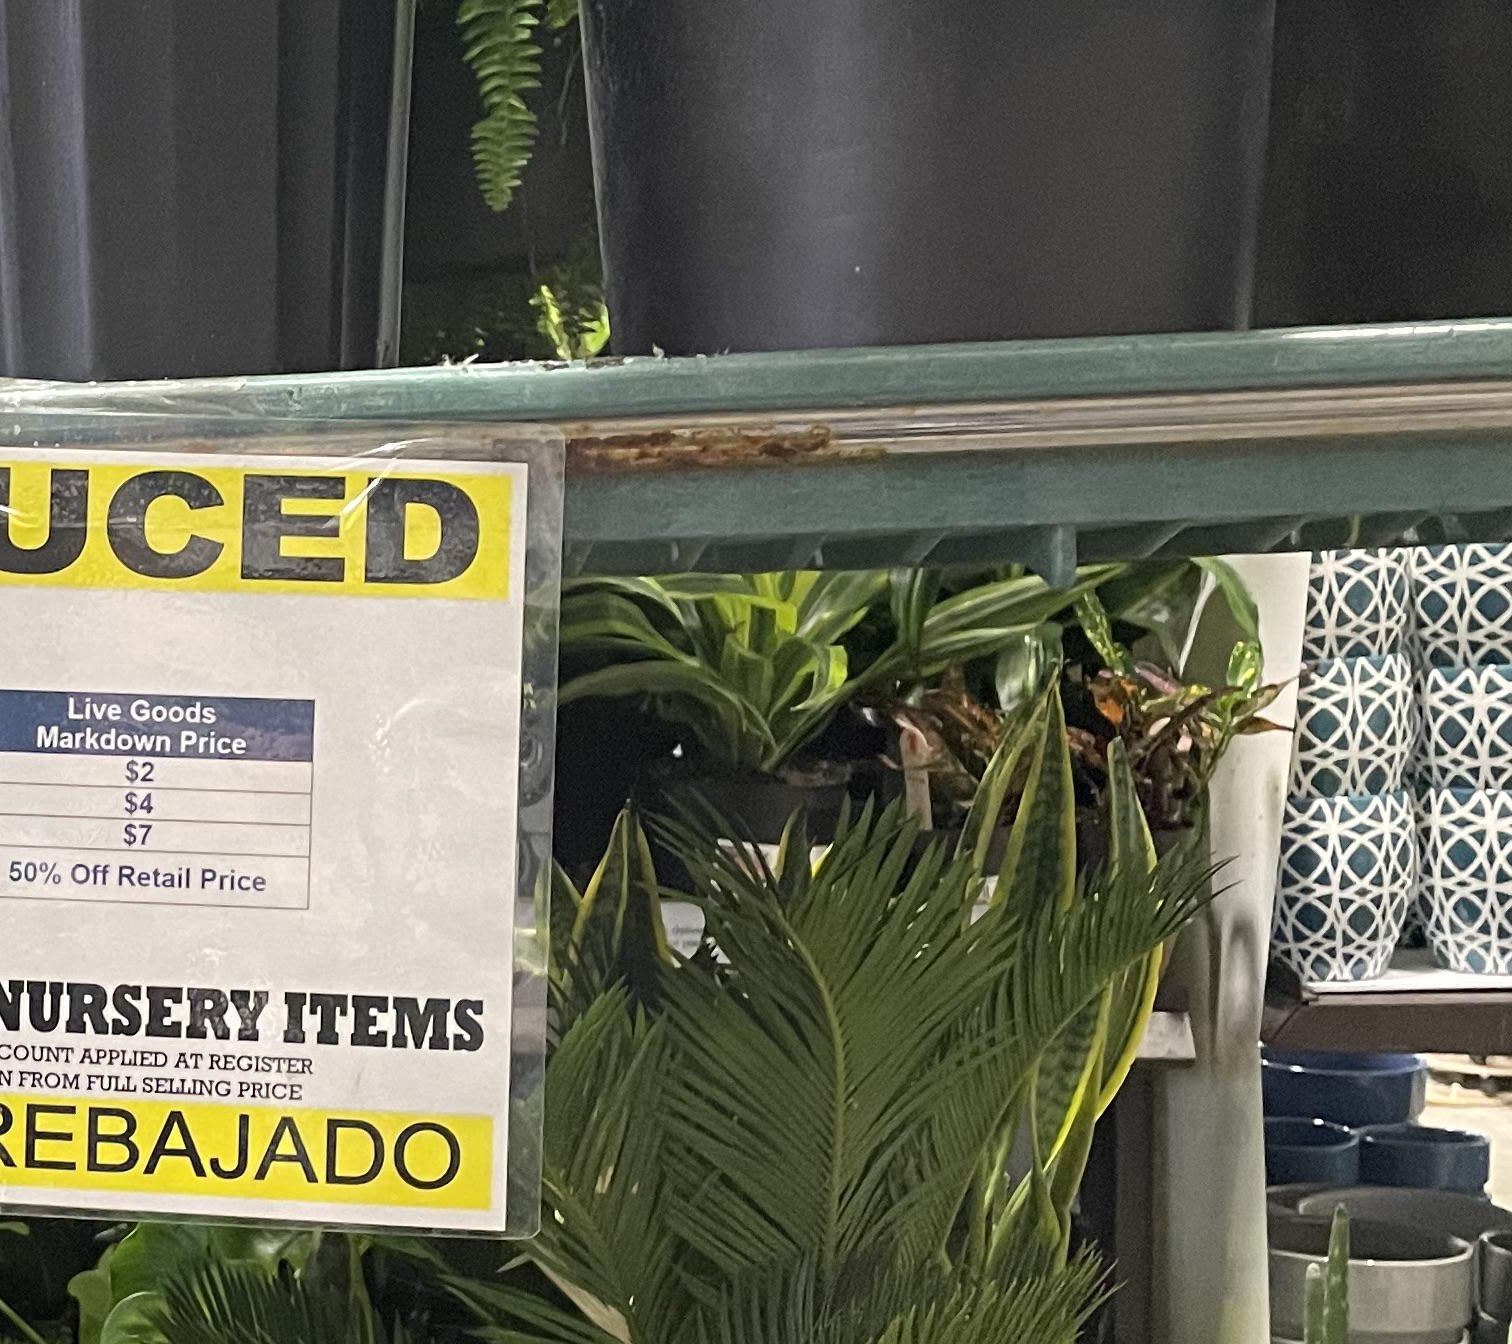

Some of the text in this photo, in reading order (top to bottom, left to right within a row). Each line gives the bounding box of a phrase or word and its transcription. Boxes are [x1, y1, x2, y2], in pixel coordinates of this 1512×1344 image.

[68, 697, 217, 724] Live Goods
[37, 726, 247, 755] Markdown Price
[124, 759, 155, 784] $2
[124, 791, 154, 816] $4
[123, 823, 153, 847] $7
[8, 861, 267, 892] 50% Off Retail Price
[284, 991, 484, 1052] ITEMS
[79, 1047, 168, 1069] APPLIED
[174, 1053, 203, 1070] AT
[209, 1054, 313, 1075] REGISTER
[19, 1070, 81, 1091] FROM
[87, 1074, 137, 1094] FULL
[142, 1076, 231, 1098] SELLING
[237, 1081, 303, 1101] PRICE
